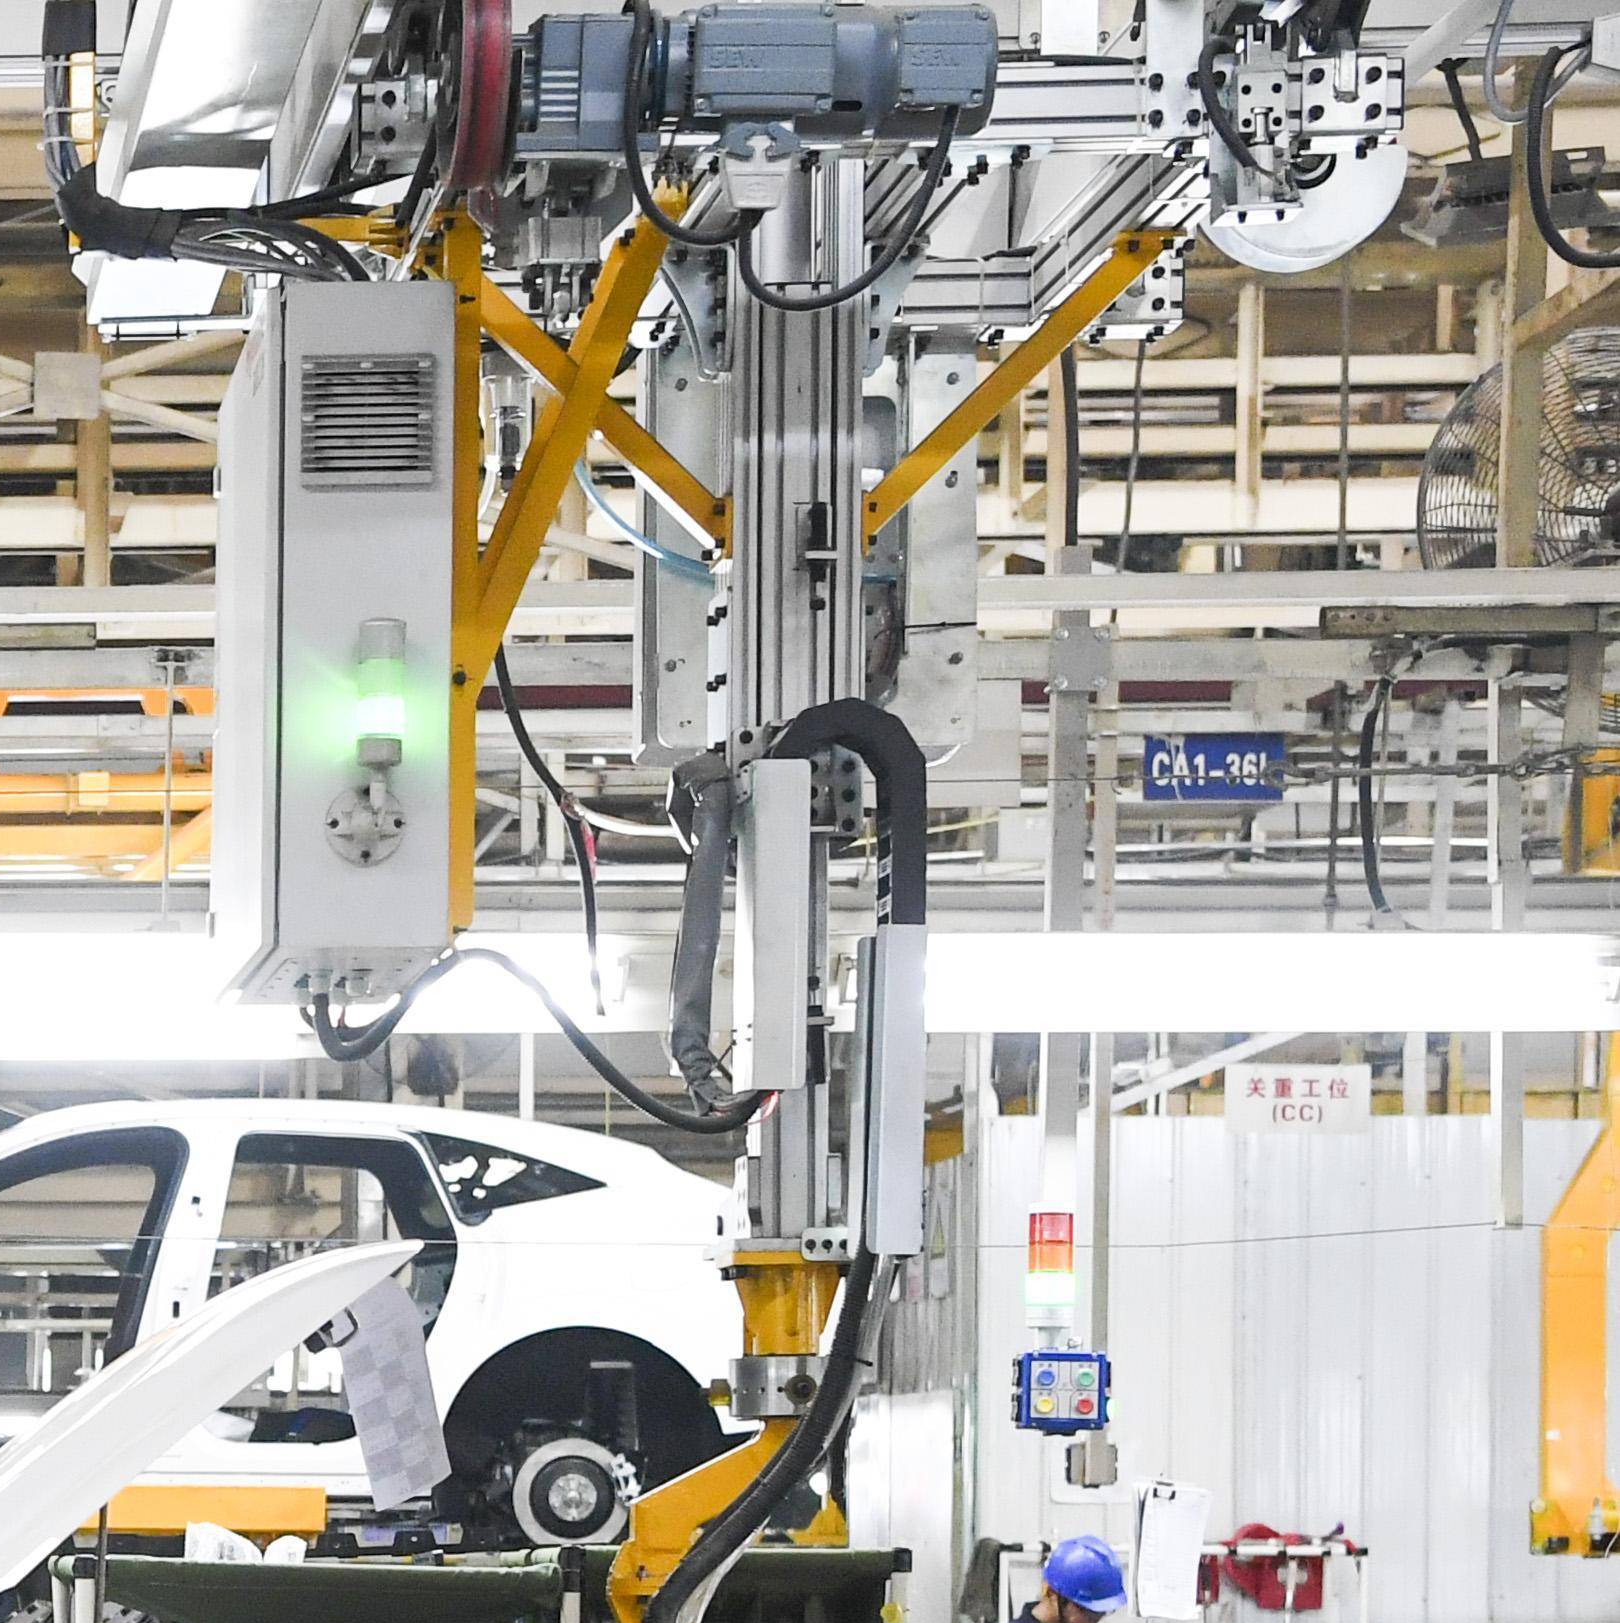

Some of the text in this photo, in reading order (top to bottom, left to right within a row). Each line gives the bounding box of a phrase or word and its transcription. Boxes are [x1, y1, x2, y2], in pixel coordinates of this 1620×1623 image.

[1245, 1077, 1351, 1100] 关重工位
[1271, 1103, 1323, 1124] (CC)
